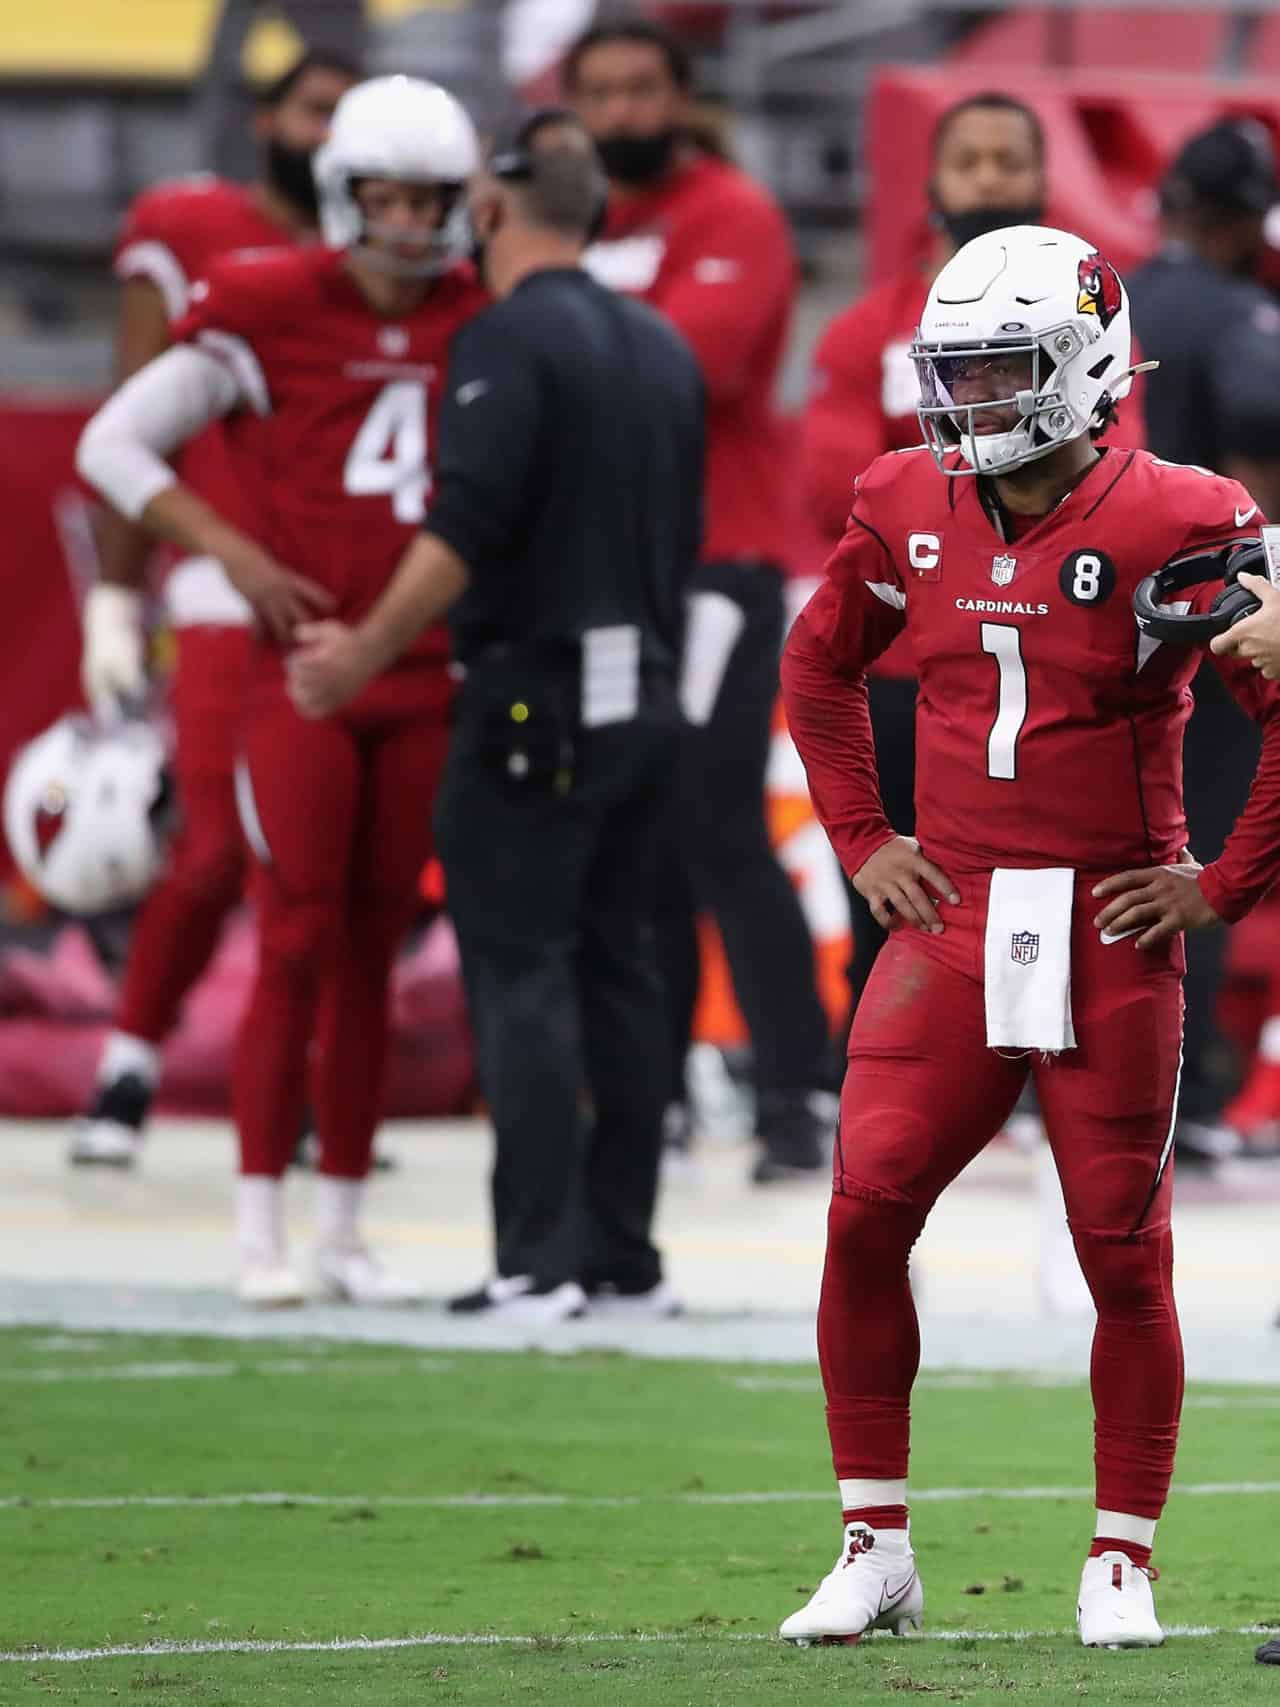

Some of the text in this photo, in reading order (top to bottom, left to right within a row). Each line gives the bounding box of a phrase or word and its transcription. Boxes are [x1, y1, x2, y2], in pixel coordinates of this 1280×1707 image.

[344, 380, 430, 523] 4
[909, 534, 940, 569] C
[1072, 554, 1101, 600] 8
[956, 599, 1048, 615] CARDINALS
[980, 621, 1026, 780] 1
[1014, 945, 1036, 961] NFL
